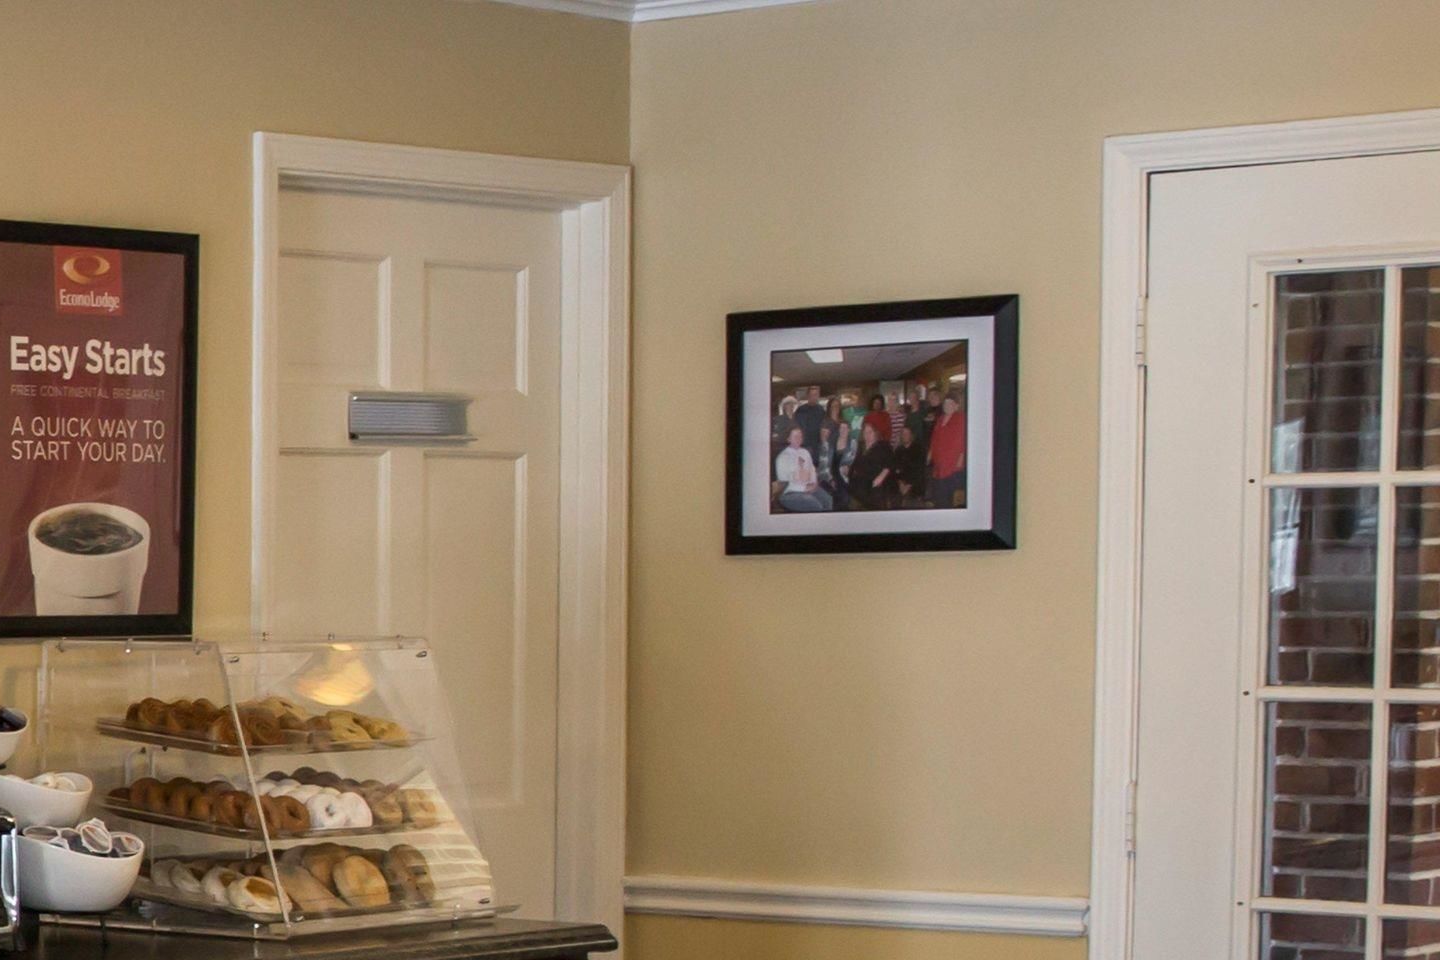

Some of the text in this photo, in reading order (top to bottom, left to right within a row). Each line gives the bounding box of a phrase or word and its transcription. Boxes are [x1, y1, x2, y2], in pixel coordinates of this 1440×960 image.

[60, 289, 120, 312] EconoLodge
[10, 335, 165, 380] Easy Starts
[10, 384, 165, 400] FREE CONTINENTAL BREAKFAST
[11, 416, 165, 440] A QUICK WAY TO
[11, 440, 166, 463] START YOUR DAY.
